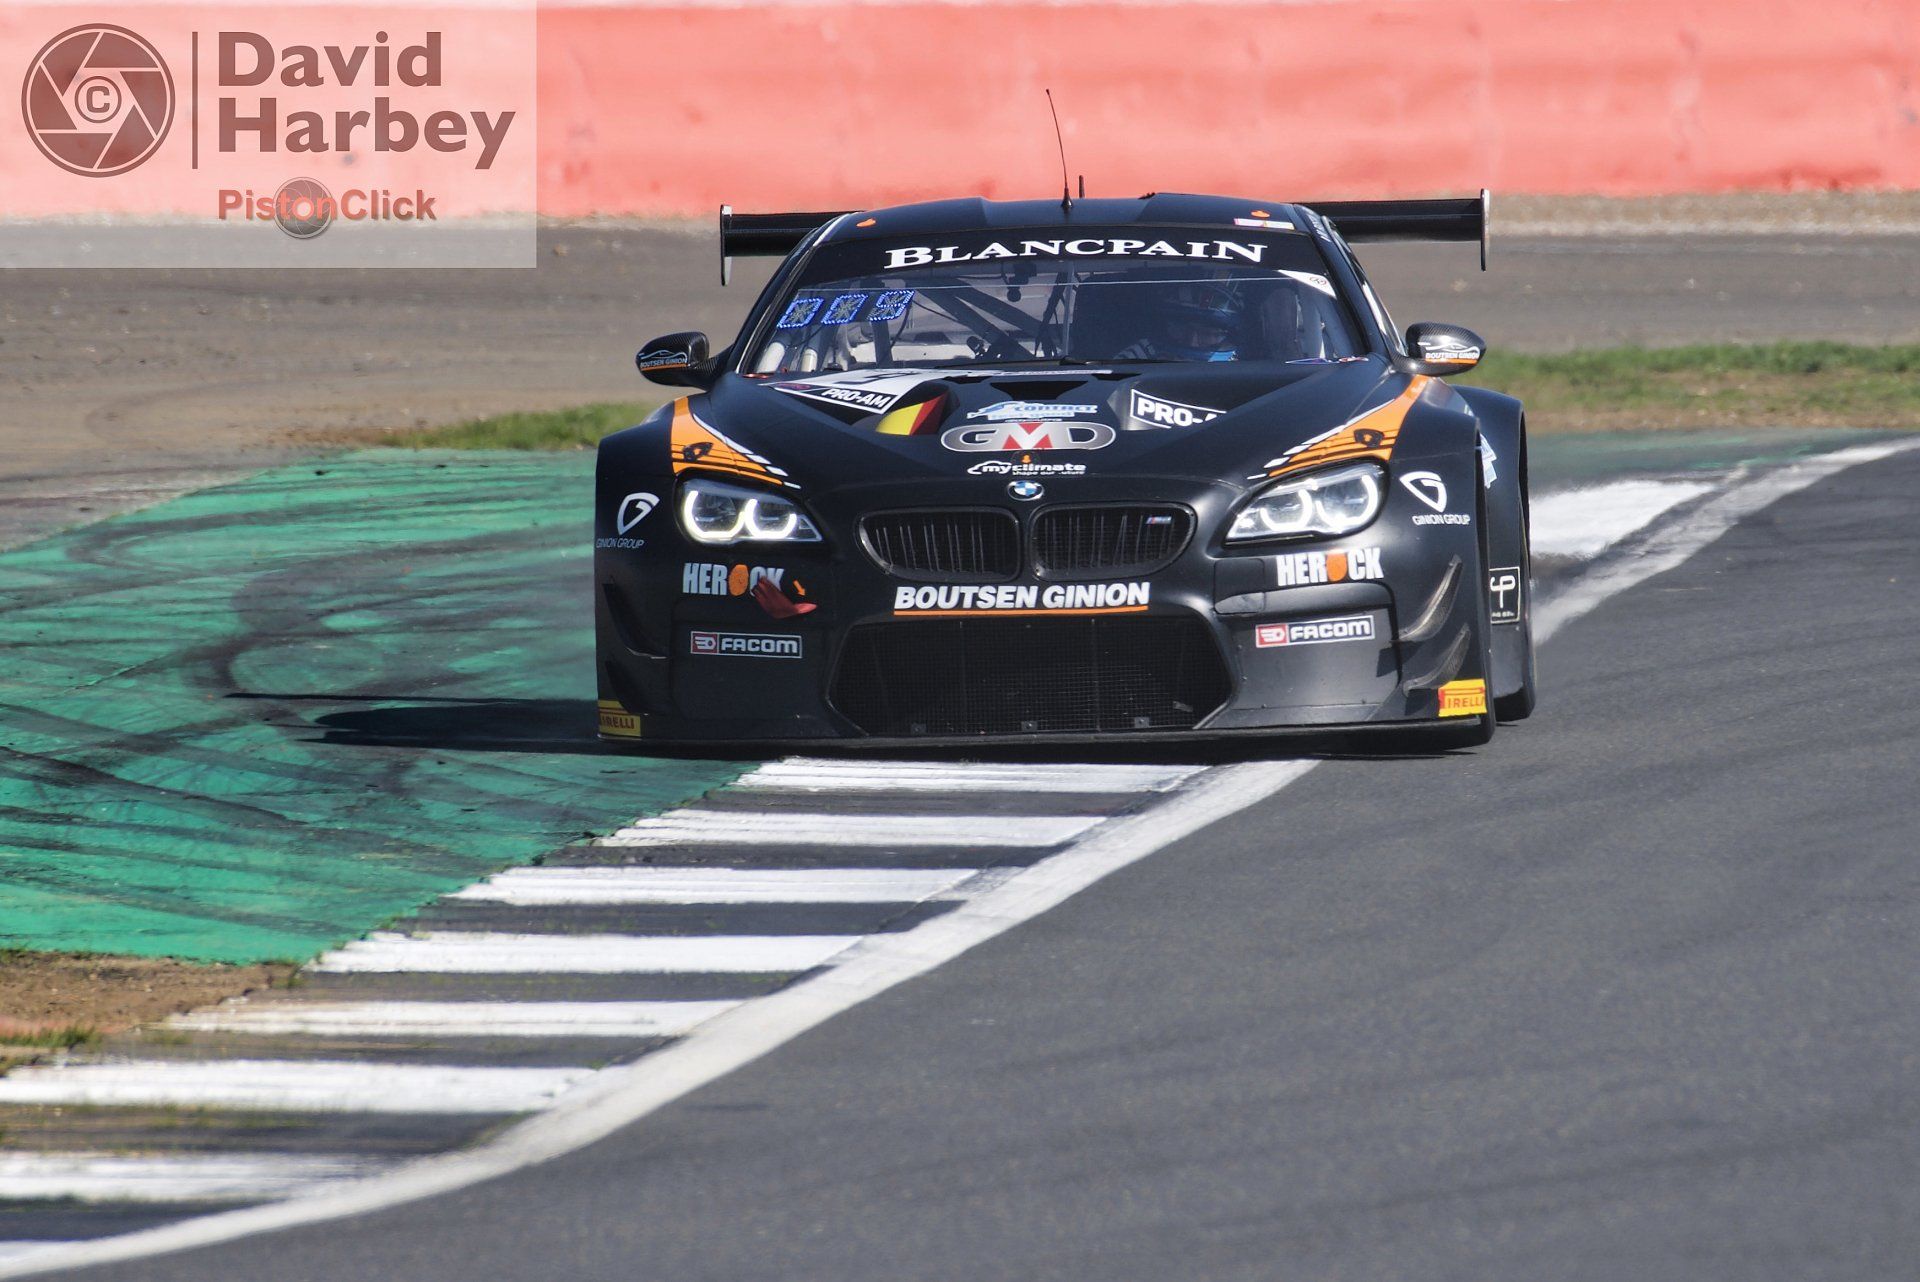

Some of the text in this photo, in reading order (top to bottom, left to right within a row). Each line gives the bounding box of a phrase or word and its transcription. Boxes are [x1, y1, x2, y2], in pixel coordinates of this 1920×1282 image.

[884, 239, 1268, 269] BLANCPAIN
[821, 388, 892, 408] PRO-AM
[940, 421, 1116, 452] GMD
[982, 463, 1087, 474] myclimate
[1277, 547, 1384, 587] HEROCK
[894, 582, 1151, 610] BOUTSEN GINION
[1289, 621, 1372, 641] FACOM
[721, 636, 799, 654] FACOM
